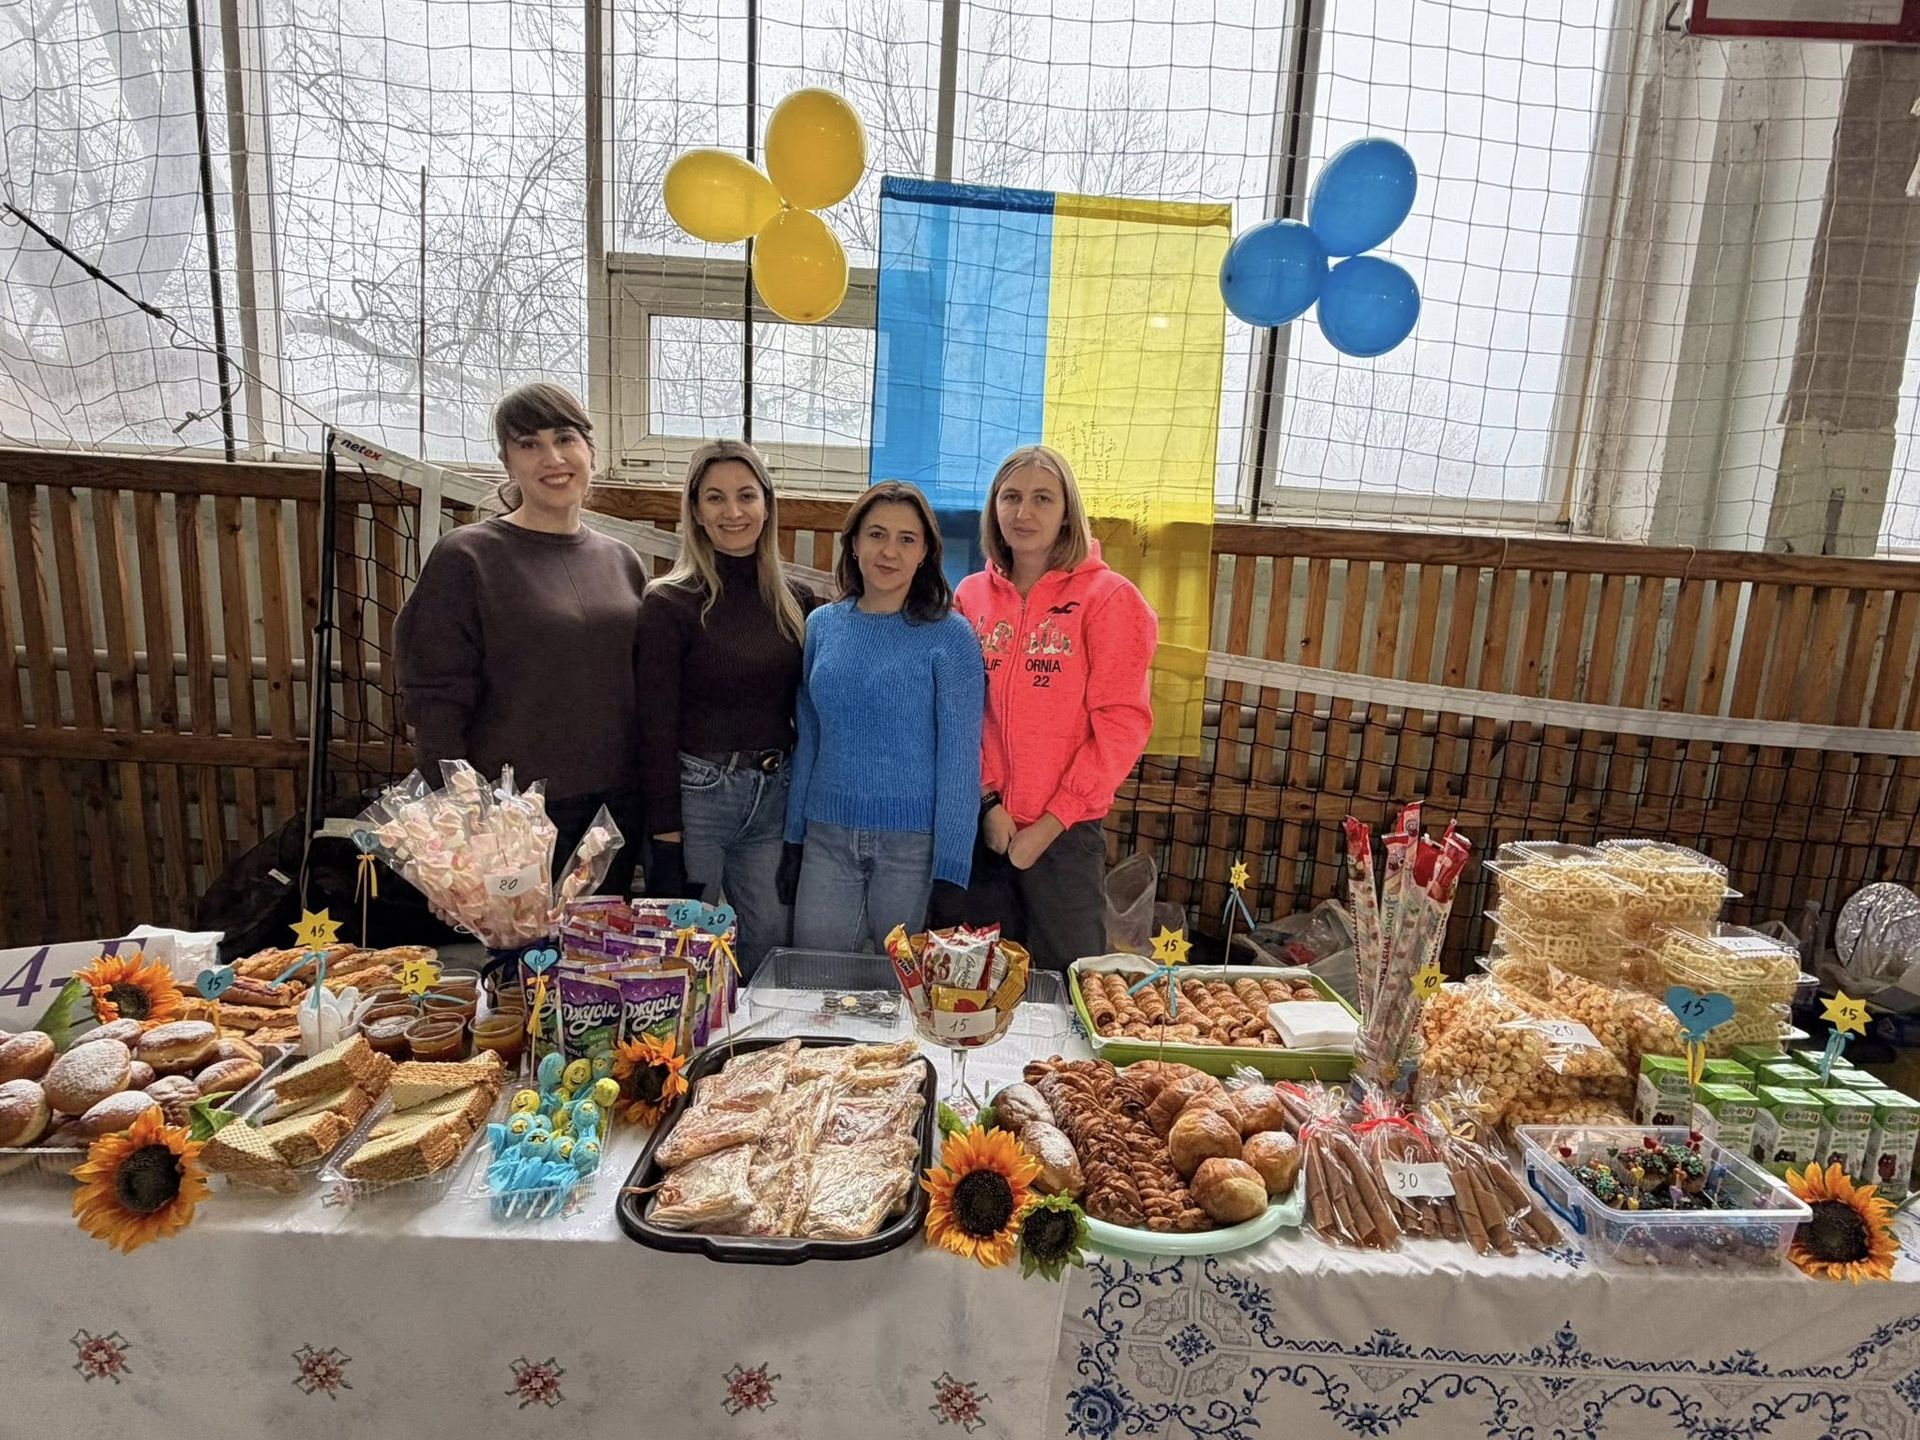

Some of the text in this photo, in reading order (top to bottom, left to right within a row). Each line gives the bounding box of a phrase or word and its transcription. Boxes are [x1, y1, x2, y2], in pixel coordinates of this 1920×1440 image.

[340, 439, 382, 461] netex
[982, 656, 1062, 672] LIF ORNIA
[1032, 675, 1050, 688] 22
[499, 878, 519, 891] 20
[674, 909, 690, 921] 15
[706, 913, 727, 926] 20
[1385, 906, 1395, 936] LONG
[310, 923, 325, 938] 15
[1163, 940, 1178, 952] 15
[207, 976, 222, 991] 15
[403, 969, 420, 986] 15
[1423, 975, 1438, 988] 10
[624, 993, 681, 1032] Джусік
[1681, 998, 1710, 1016] 15
[1840, 1006, 1859, 1020] 15
[563, 1001, 620, 1035] Джусік
[948, 1018, 970, 1033] 15
[1553, 1025, 1574, 1037] 20
[1398, 1172, 1418, 1189] 30
